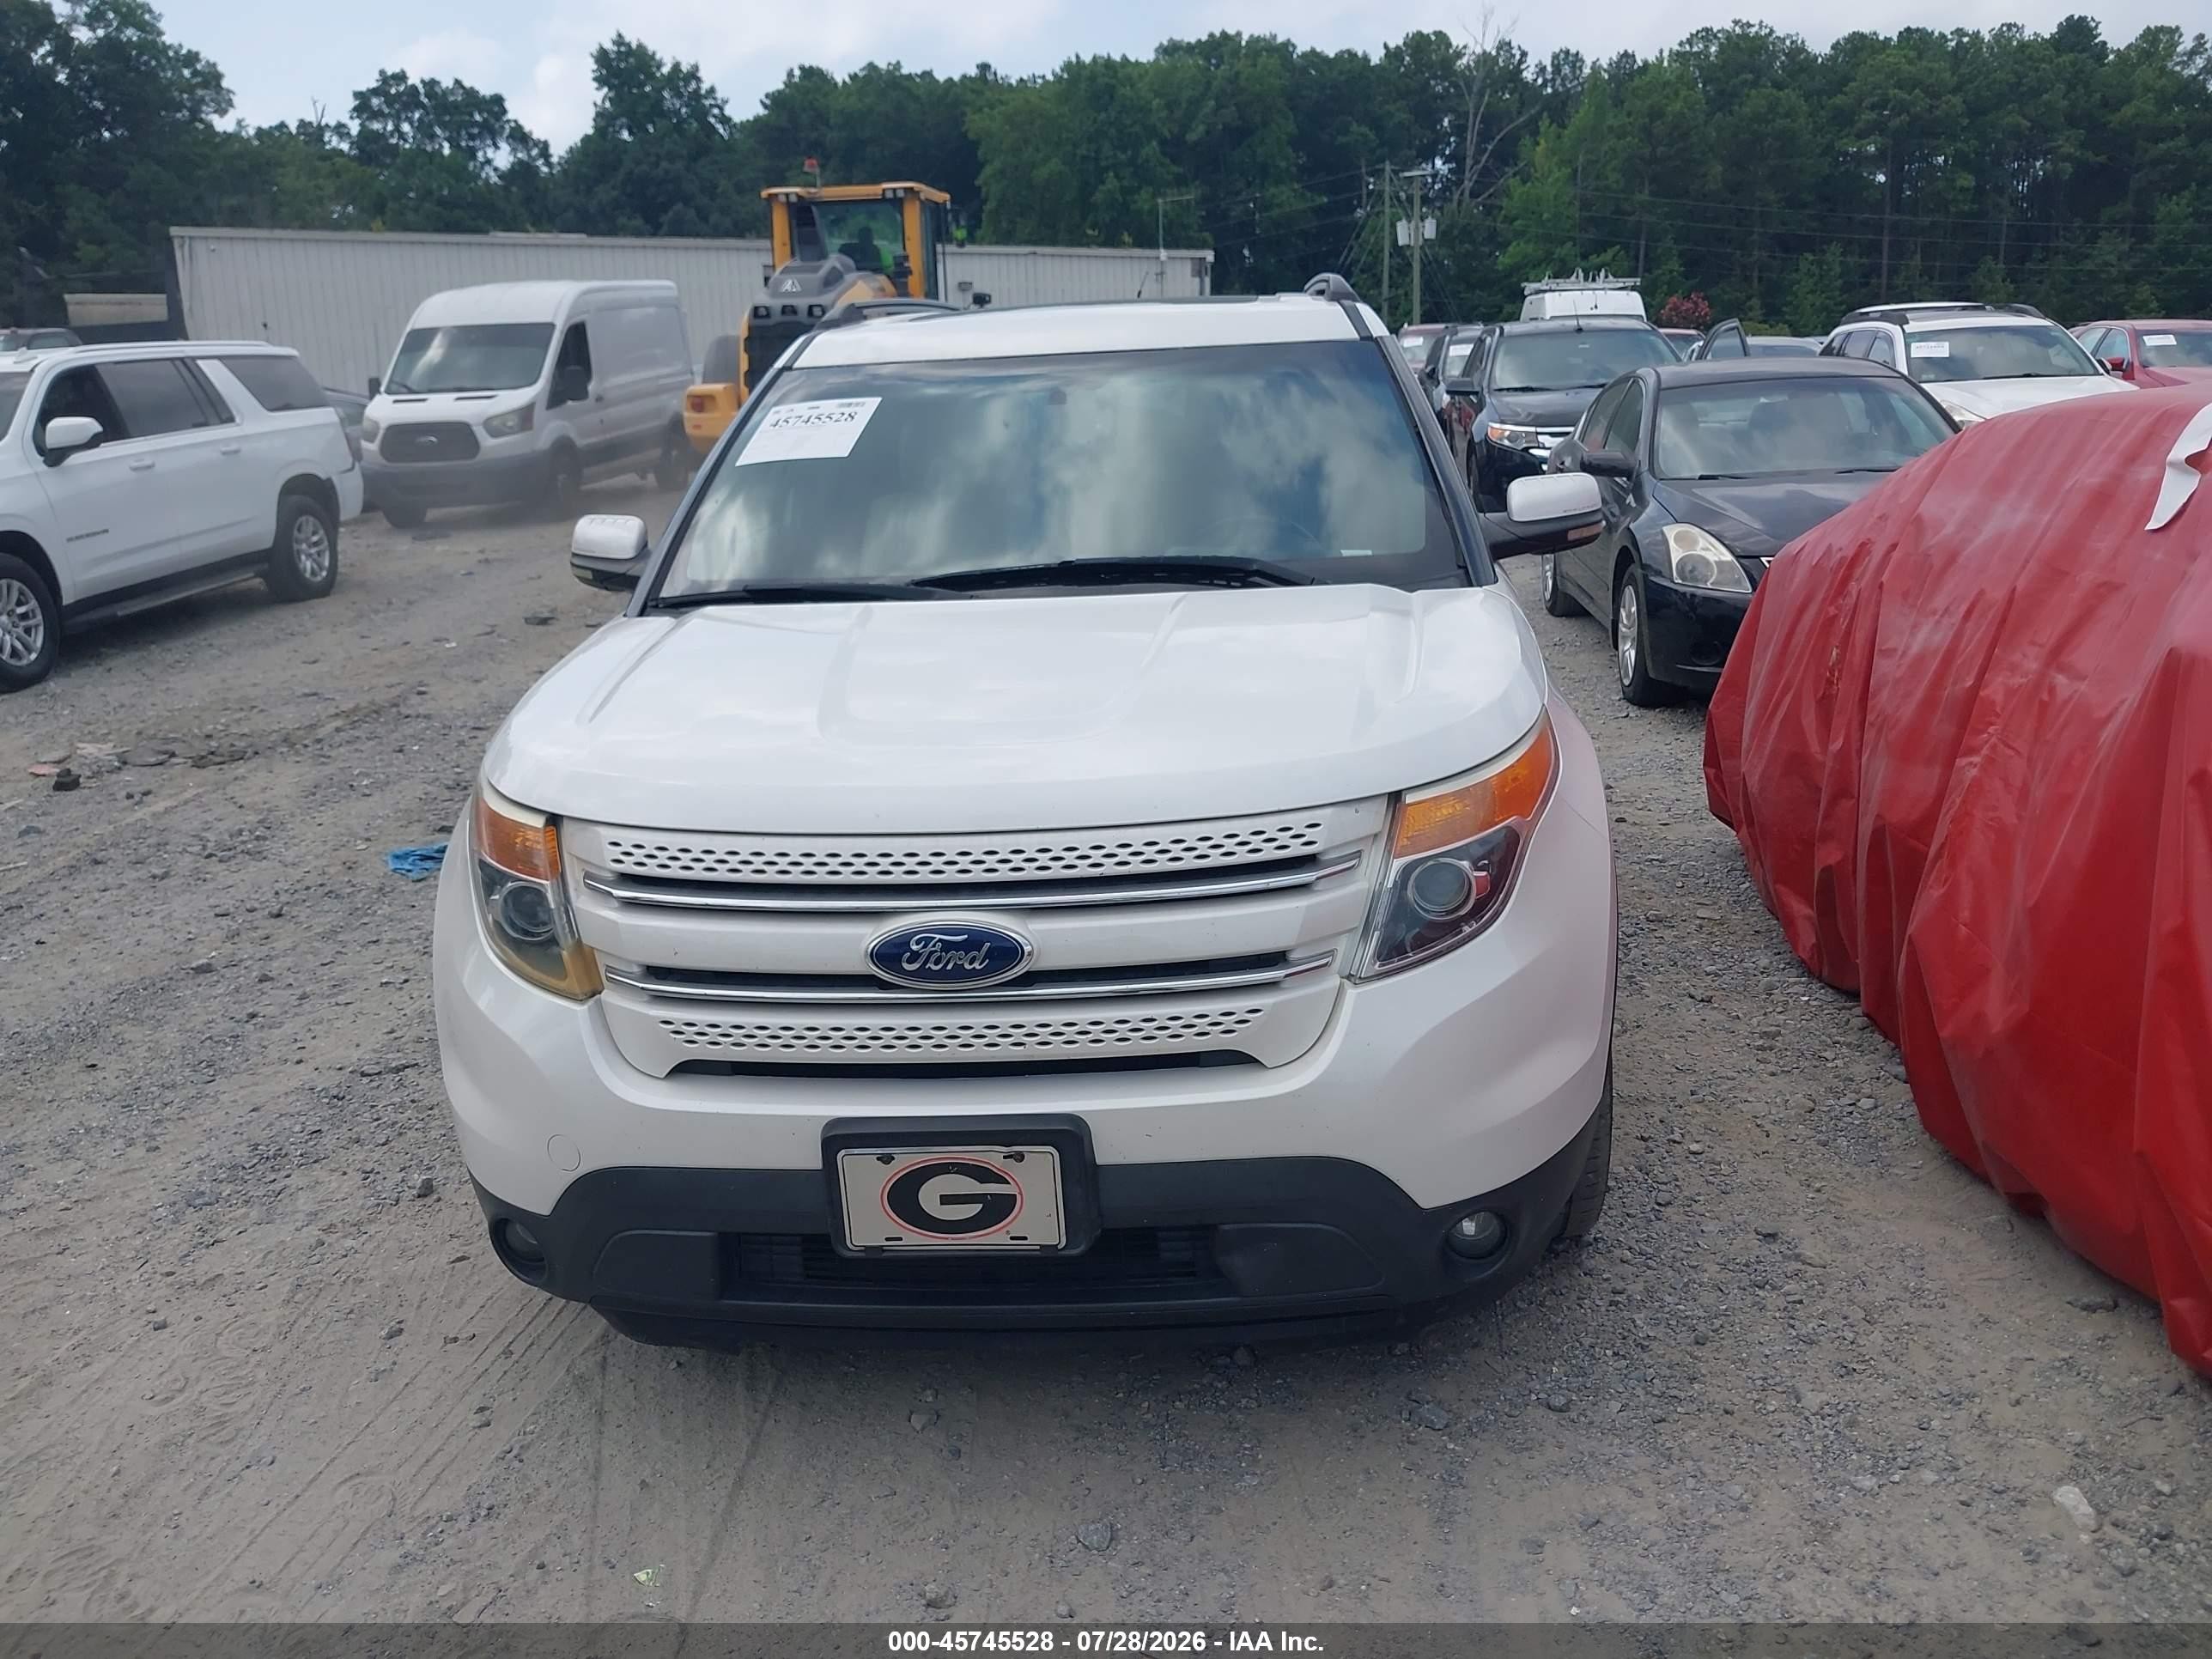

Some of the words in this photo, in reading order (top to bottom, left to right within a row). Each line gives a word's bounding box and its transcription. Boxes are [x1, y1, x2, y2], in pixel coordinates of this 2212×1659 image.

[769, 411, 858, 428] 45745528
[902, 933, 991, 971] Ford
[886, 1162, 1018, 1235] G
